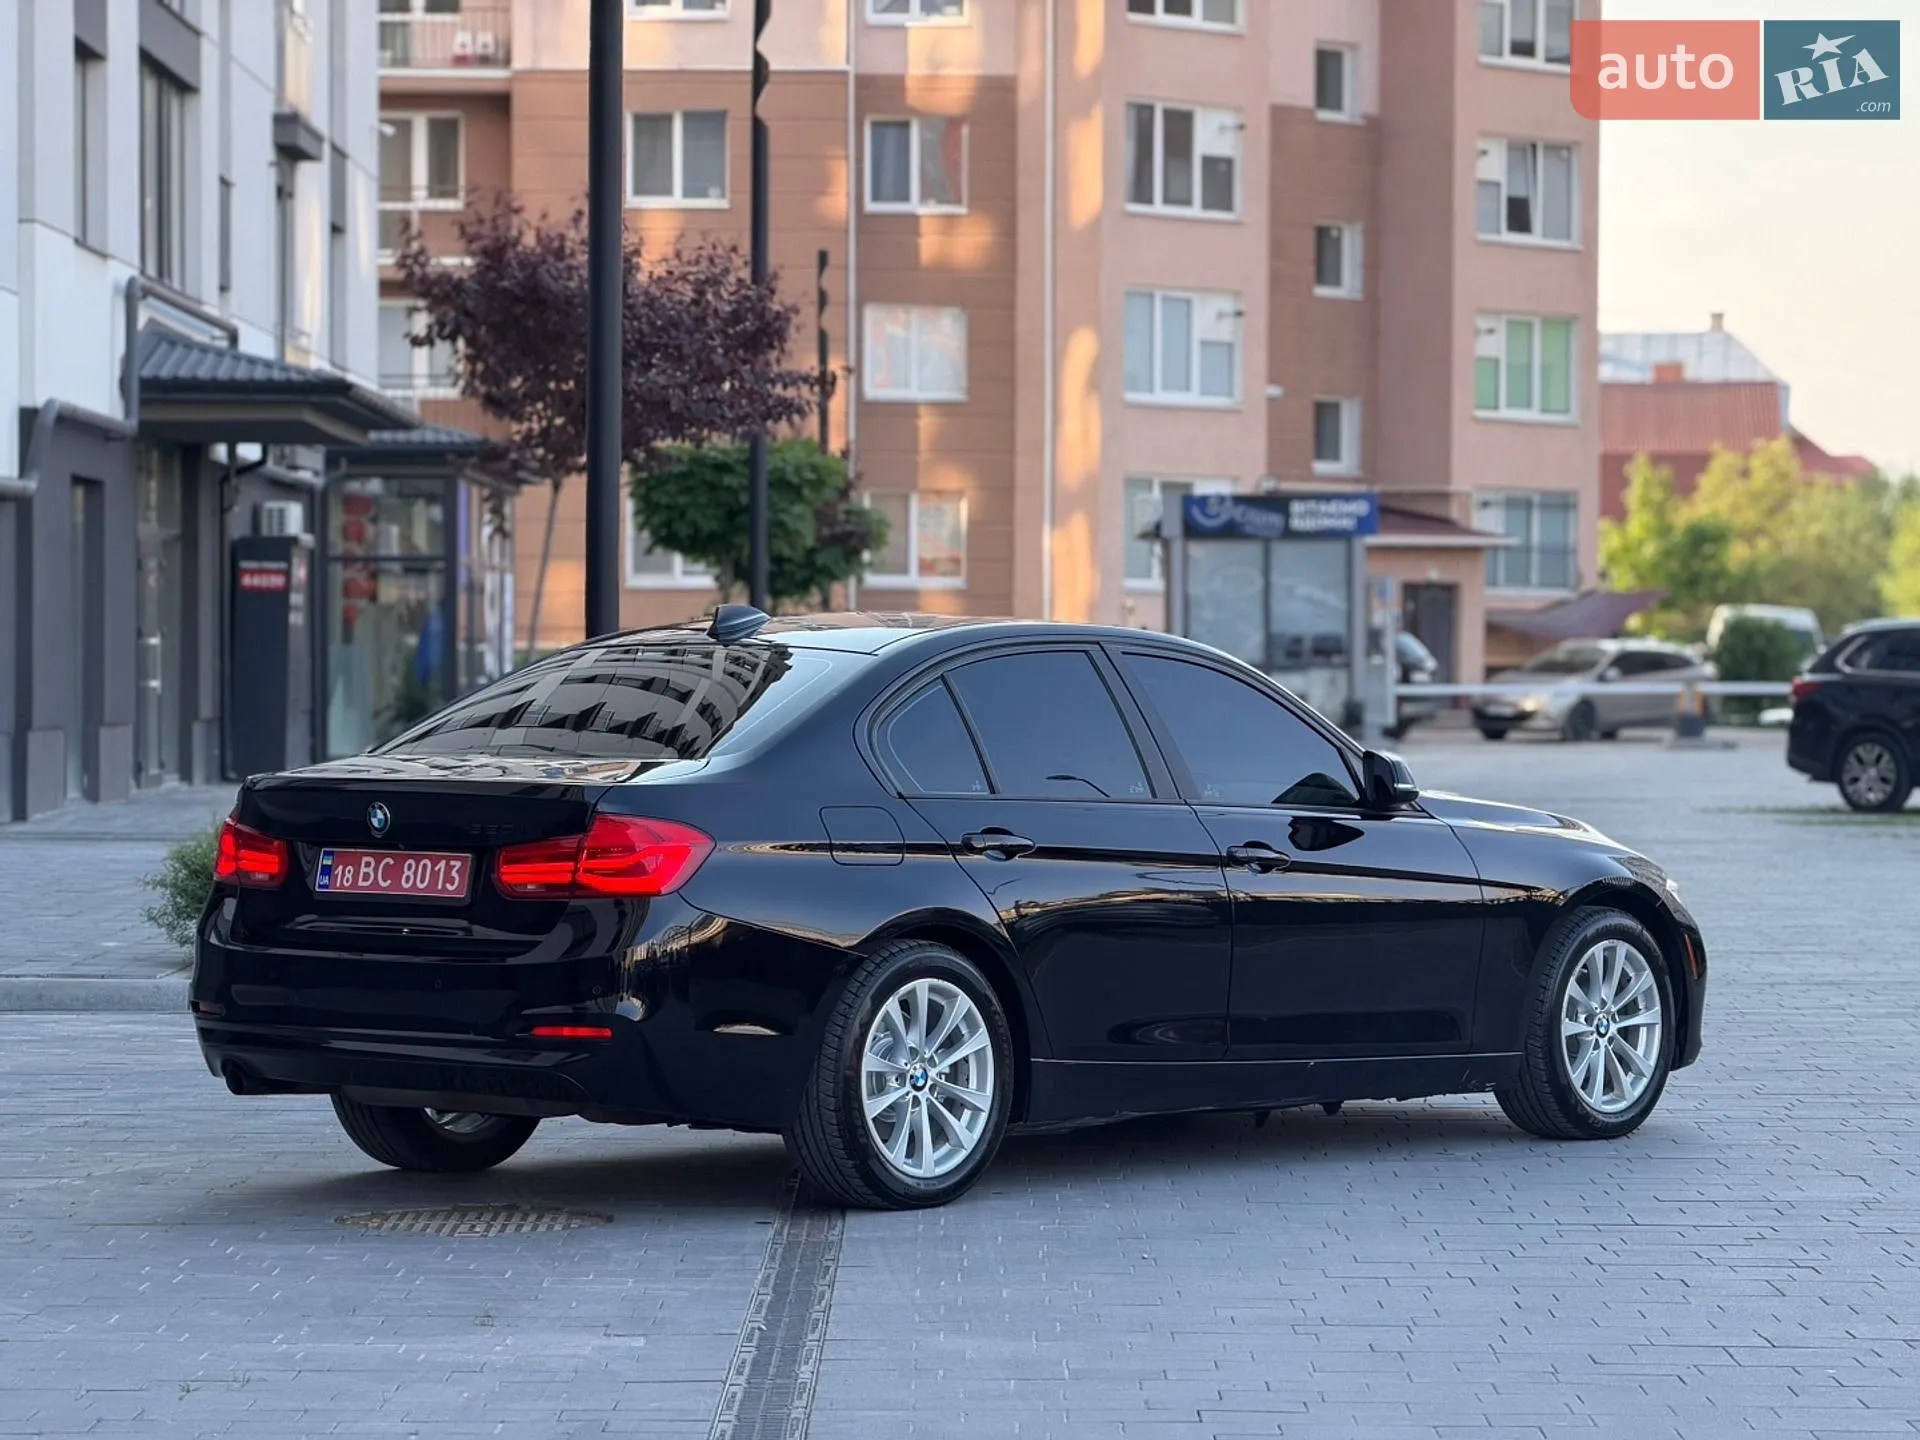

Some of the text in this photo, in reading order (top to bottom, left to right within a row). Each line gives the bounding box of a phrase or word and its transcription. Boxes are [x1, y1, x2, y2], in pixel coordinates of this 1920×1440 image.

[319, 875, 329, 885] UA
[334, 855, 462, 891] 18 BC 8013
